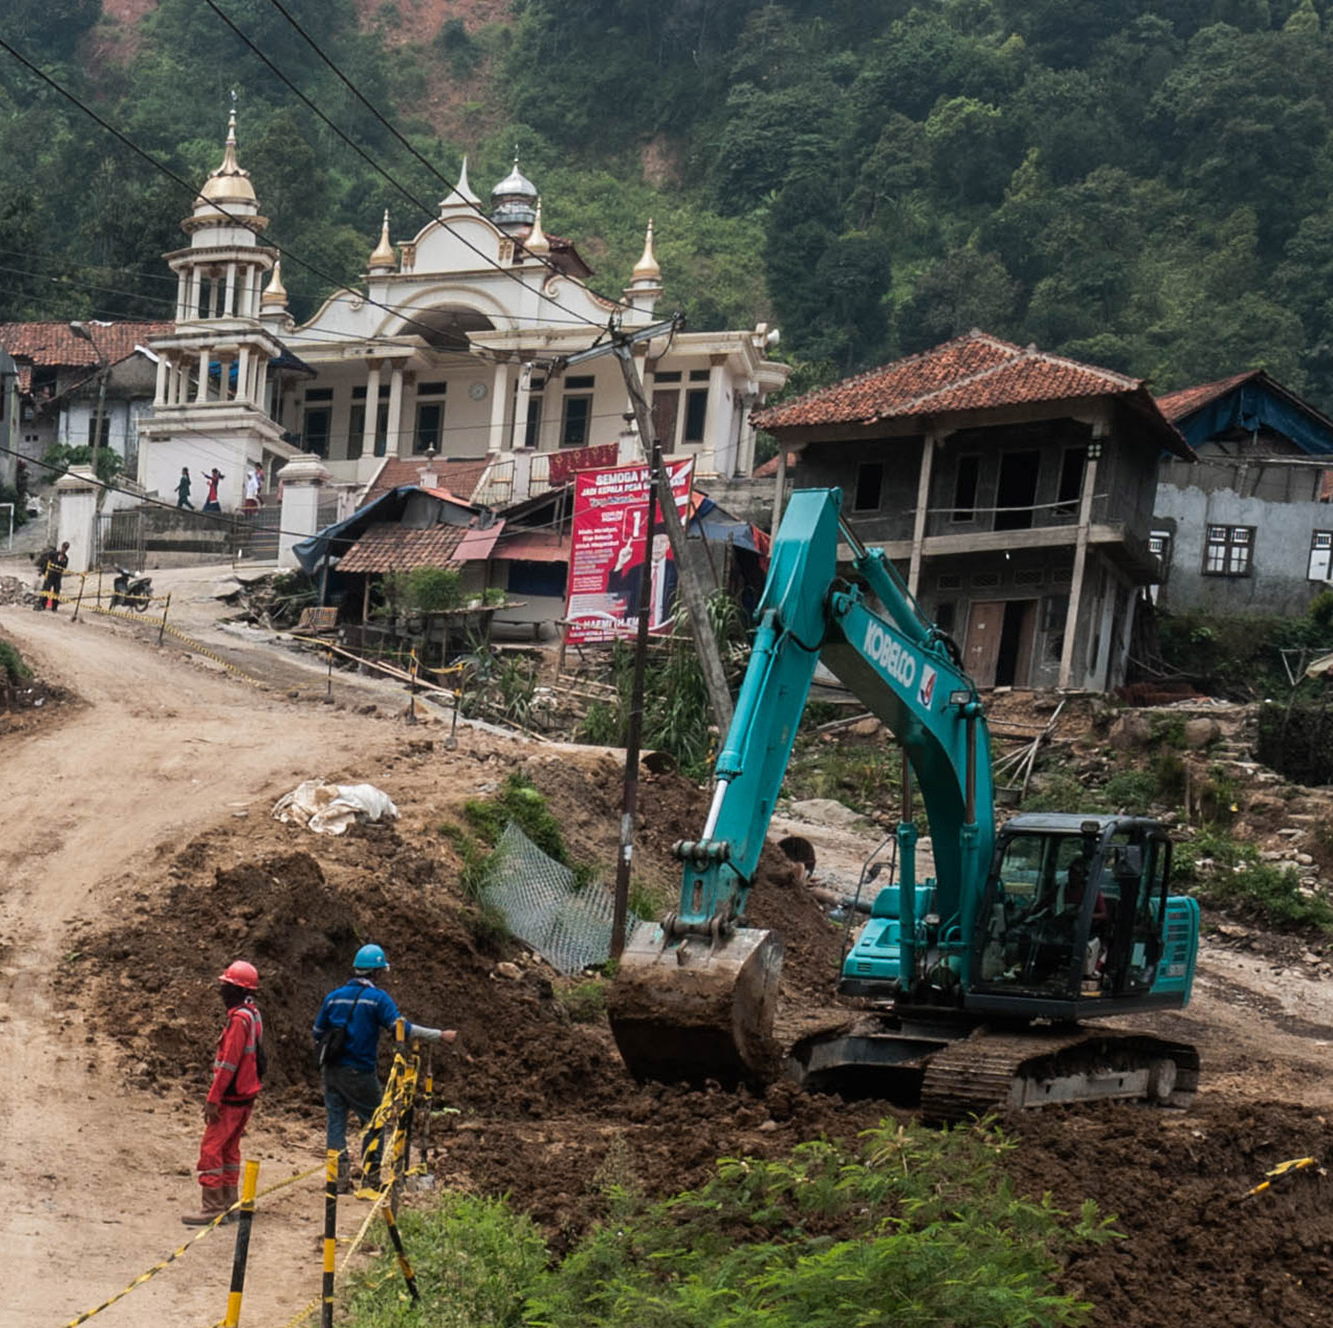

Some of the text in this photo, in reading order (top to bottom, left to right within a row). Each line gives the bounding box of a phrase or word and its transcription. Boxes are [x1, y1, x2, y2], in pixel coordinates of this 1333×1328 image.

[595, 470, 638, 486] SEMOGA
[598, 484, 623, 495] KEPALA
[633, 511, 641, 538] 1
[863, 618, 916, 689] KOBELCO
